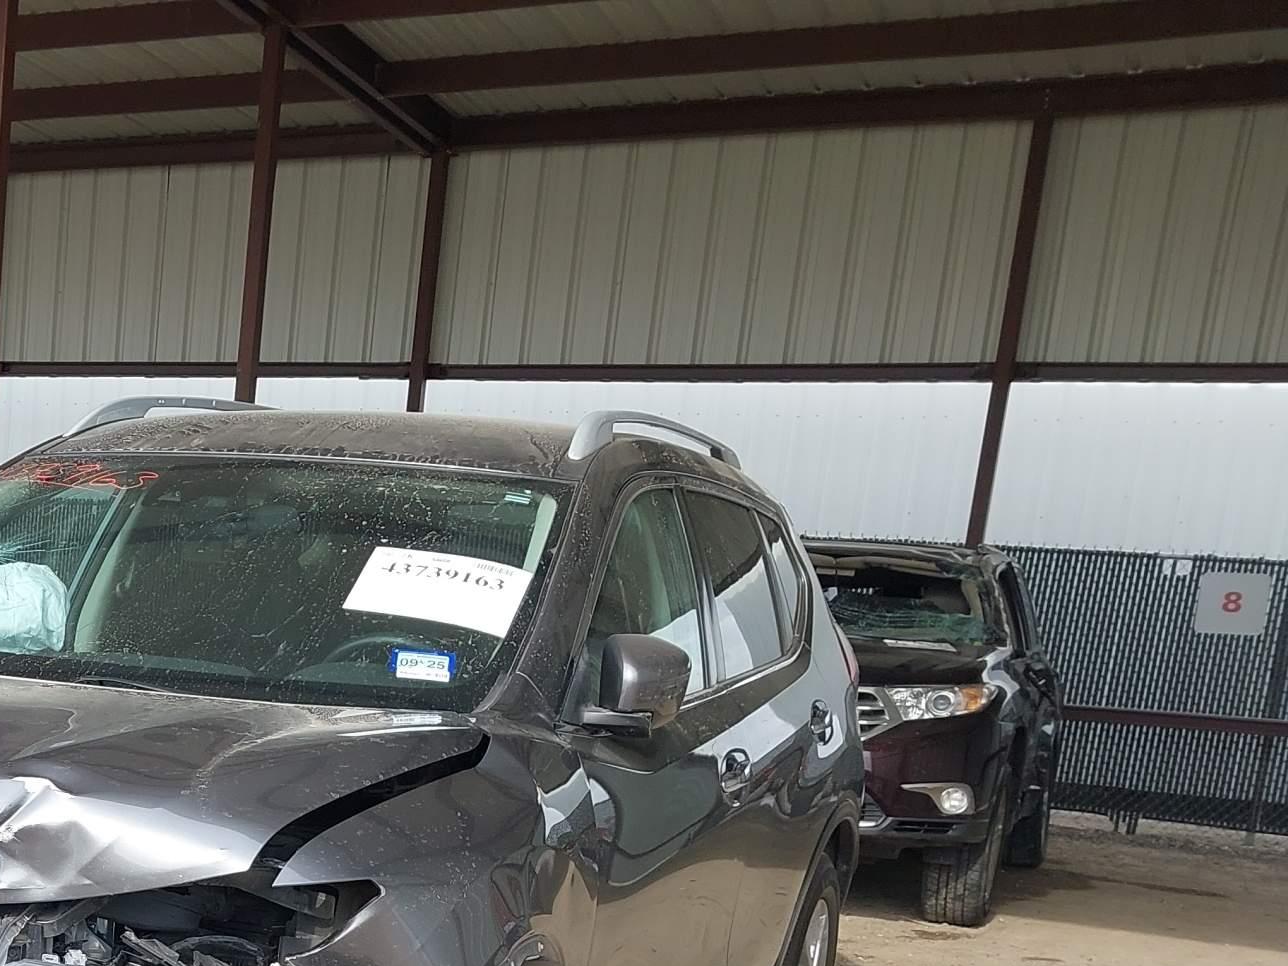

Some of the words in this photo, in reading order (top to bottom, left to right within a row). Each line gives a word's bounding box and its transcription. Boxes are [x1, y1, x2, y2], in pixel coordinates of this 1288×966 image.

[381, 562, 505, 591] 43739163
[1222, 591, 1242, 613] 8
[400, 657, 418, 667] 09
[426, 660, 445, 670] 25
